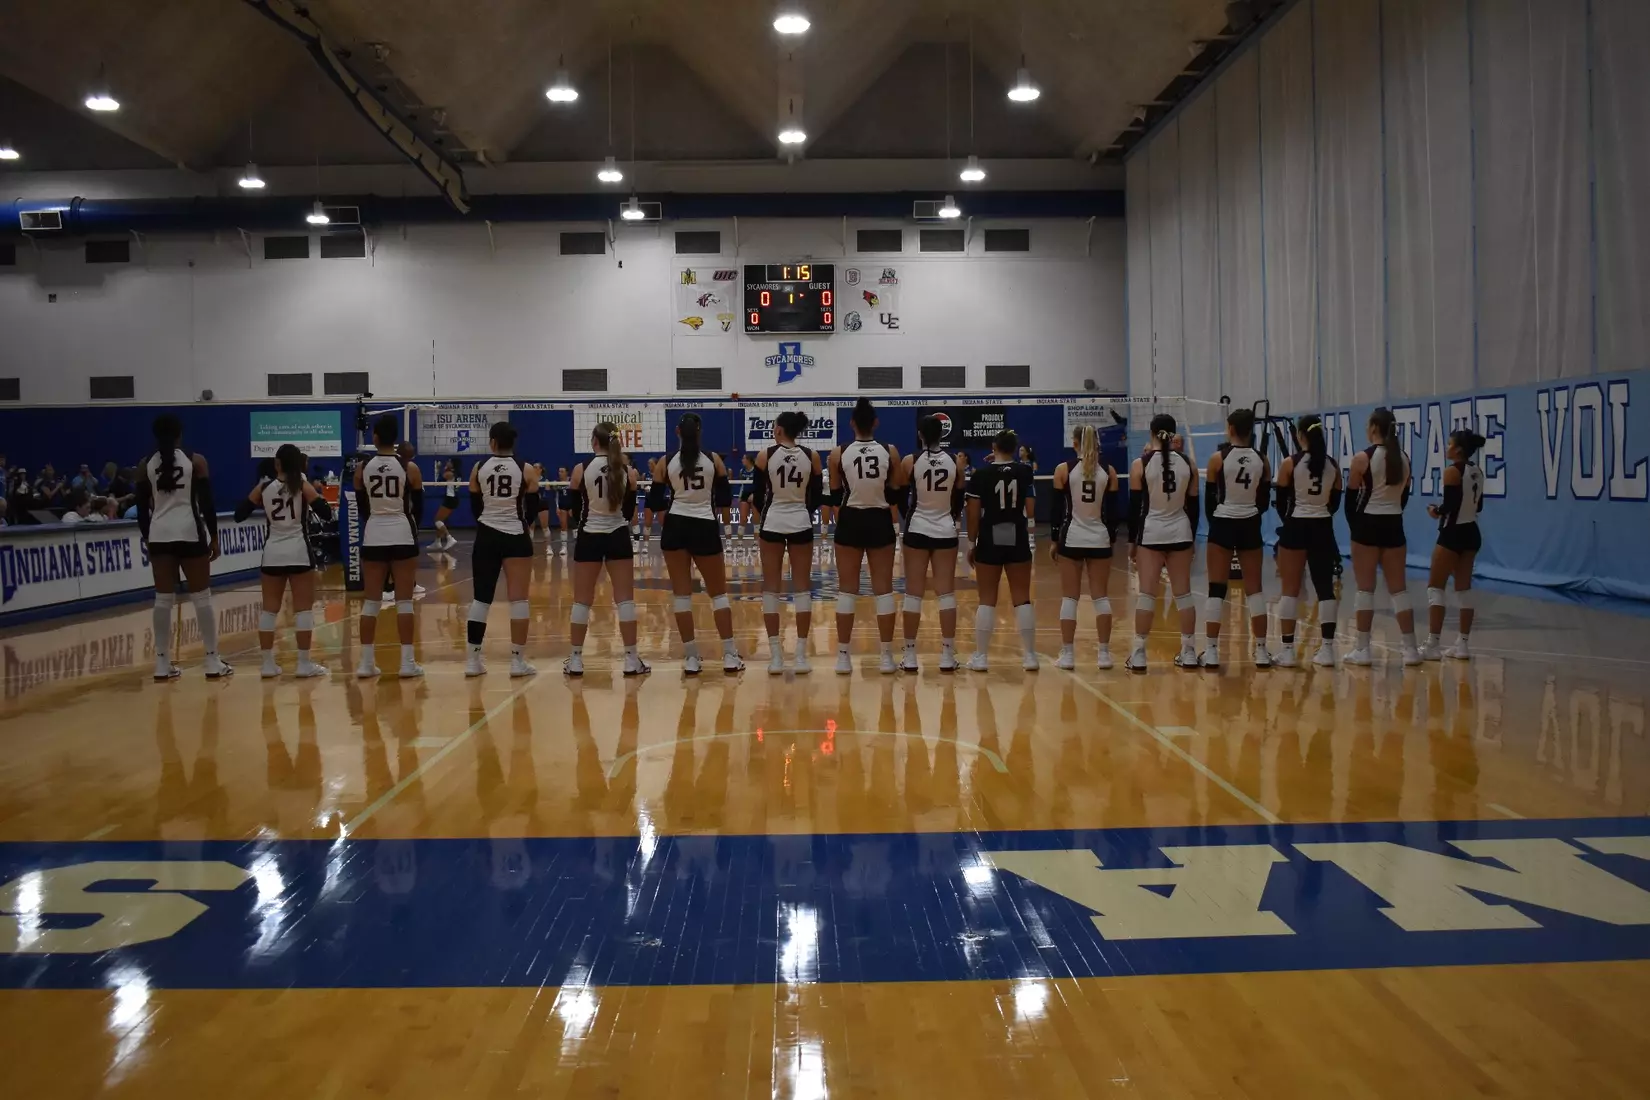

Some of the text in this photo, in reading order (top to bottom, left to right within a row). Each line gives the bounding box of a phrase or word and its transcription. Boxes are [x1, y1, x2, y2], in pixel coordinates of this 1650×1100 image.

[713, 270, 739, 281] UIC
[783, 265, 810, 280] 1:15
[746, 283, 779, 291] SYCAMORES
[808, 282, 831, 290] GUEST
[760, 291, 770, 307] 0
[822, 290, 832, 306] 0
[751, 312, 759, 325] 0
[823, 312, 832, 324] 0
[765, 354, 815, 367] SYCAMORES
[437, 414, 488, 424] ISU ARENA
[596, 411, 642, 424] tropical
[749, 417, 776, 429] Ter
[982, 413, 1004, 421] PROUDLY
[973, 421, 1004, 429] SUPPORTING
[763, 430, 819, 439] CHLET
[963, 429, 972, 437] THE
[853, 456, 880, 479] 13
[776, 465, 803, 488] 14
[922, 468, 948, 492] 12
[1235, 466, 1251, 489] 4
[369, 475, 400, 498] 20
[486, 474, 512, 498] 18
[1081, 480, 1096, 502] 9
[1307, 473, 1322, 496] 3
[994, 479, 1018, 509] 11
[270, 498, 296, 521] 21
[2, 542, 84, 587] INDIANA
[87, 537, 131, 574] STATE
[349, 546, 360, 581] STATE
